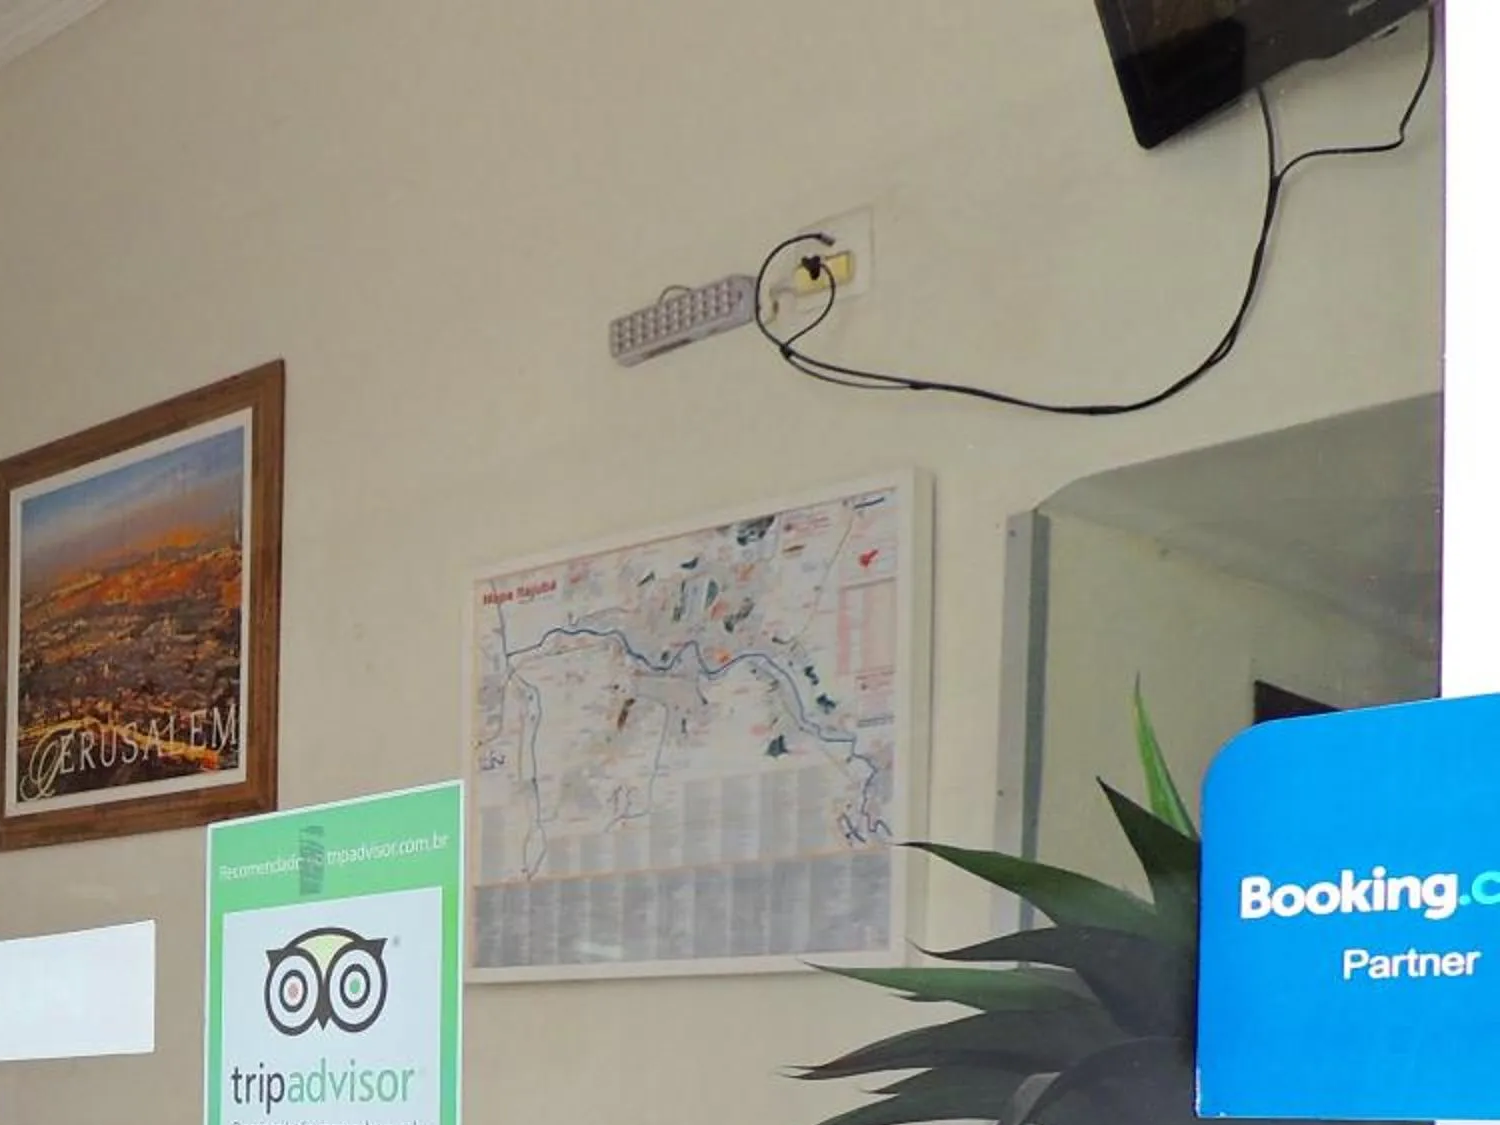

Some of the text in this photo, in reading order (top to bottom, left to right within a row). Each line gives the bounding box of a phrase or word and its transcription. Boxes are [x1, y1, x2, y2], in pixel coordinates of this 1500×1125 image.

[19, 702, 238, 801] JERUSALEM
[1342, 948, 1482, 980] Partner
[231, 1057, 415, 1115] tripadvisor
